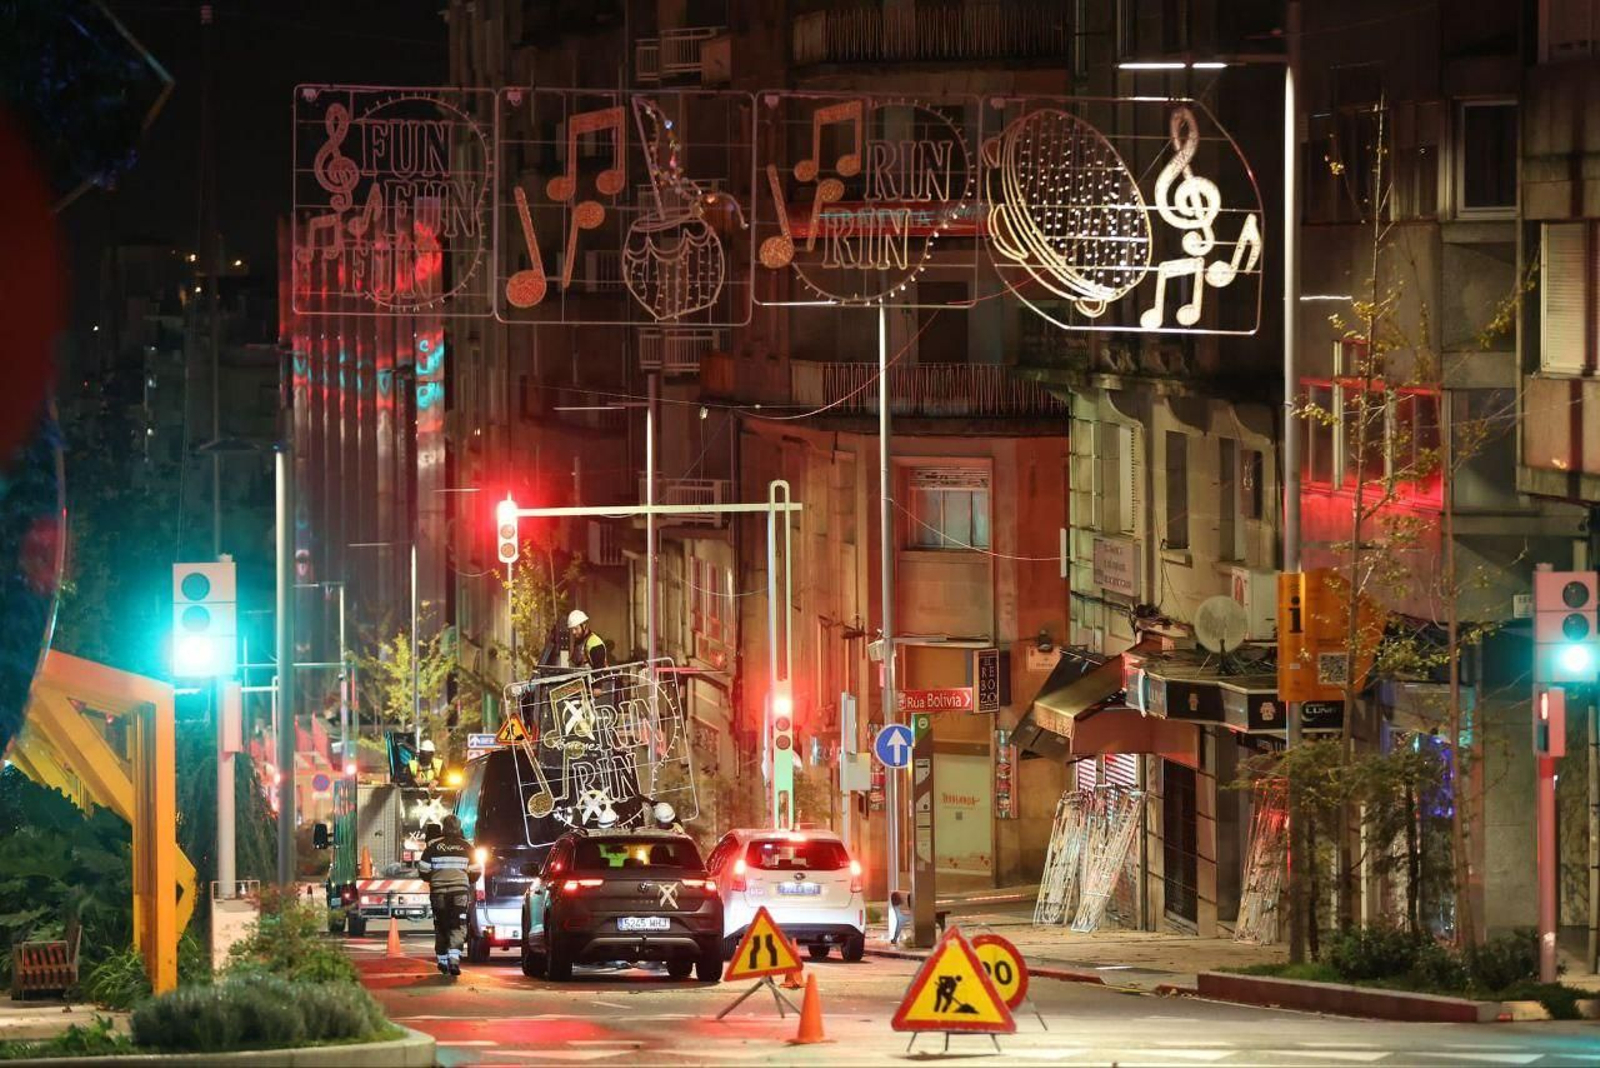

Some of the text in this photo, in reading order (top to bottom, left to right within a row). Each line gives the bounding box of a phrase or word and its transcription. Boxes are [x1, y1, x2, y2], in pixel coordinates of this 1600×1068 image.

[361, 119, 454, 178] FUN
[864, 140, 953, 201] RIN
[384, 179, 475, 237] FUN
[822, 208, 911, 270] RIN
[594, 697, 663, 750] RIN
[572, 753, 641, 809] RIN
